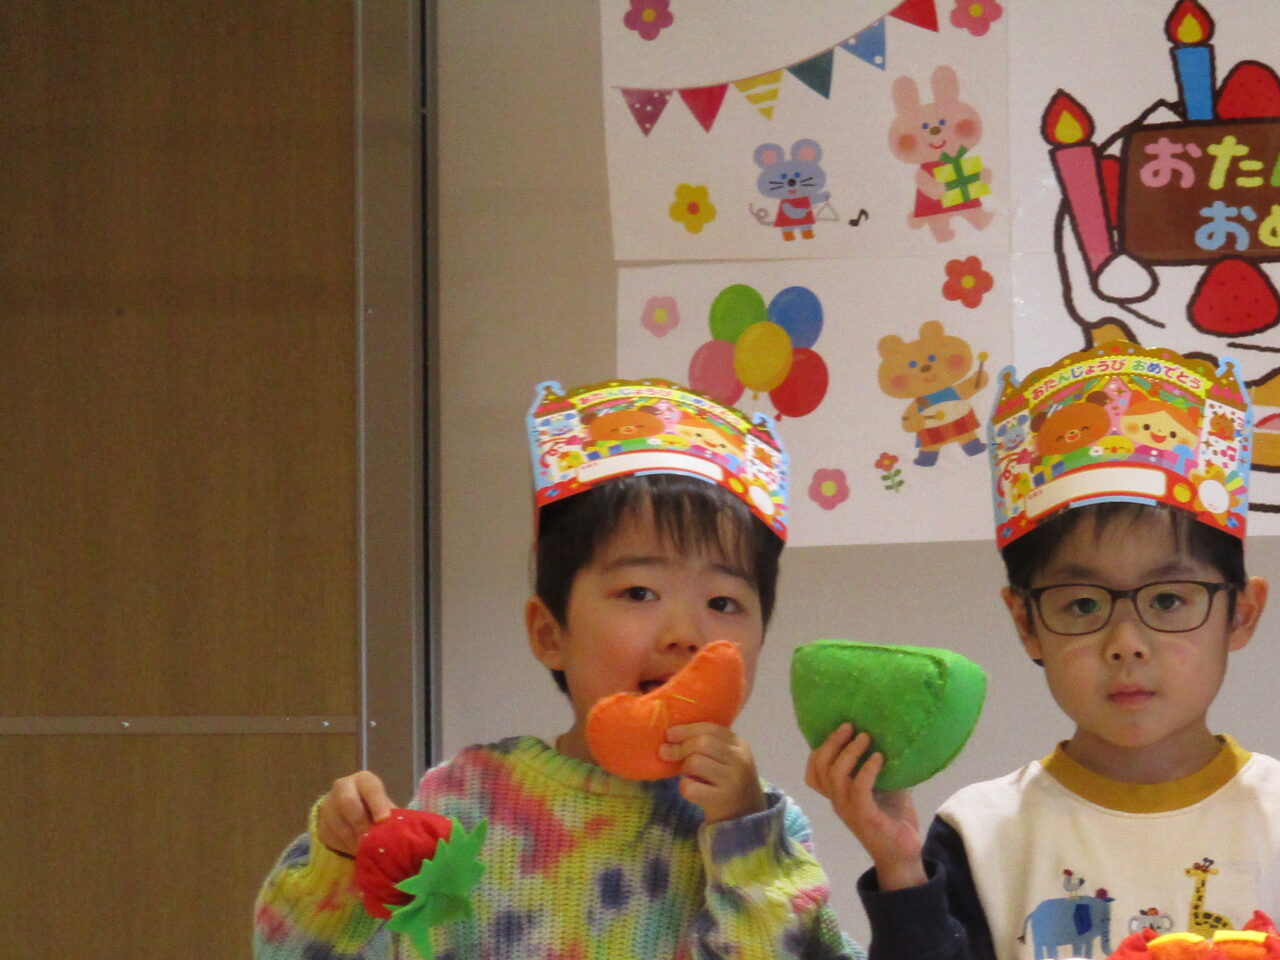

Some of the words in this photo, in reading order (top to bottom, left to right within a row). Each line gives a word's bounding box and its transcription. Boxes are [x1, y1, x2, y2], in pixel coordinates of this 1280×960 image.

[1031, 358, 1127, 400] おたんじょうび
[1132, 359, 1202, 390] おめでとう
